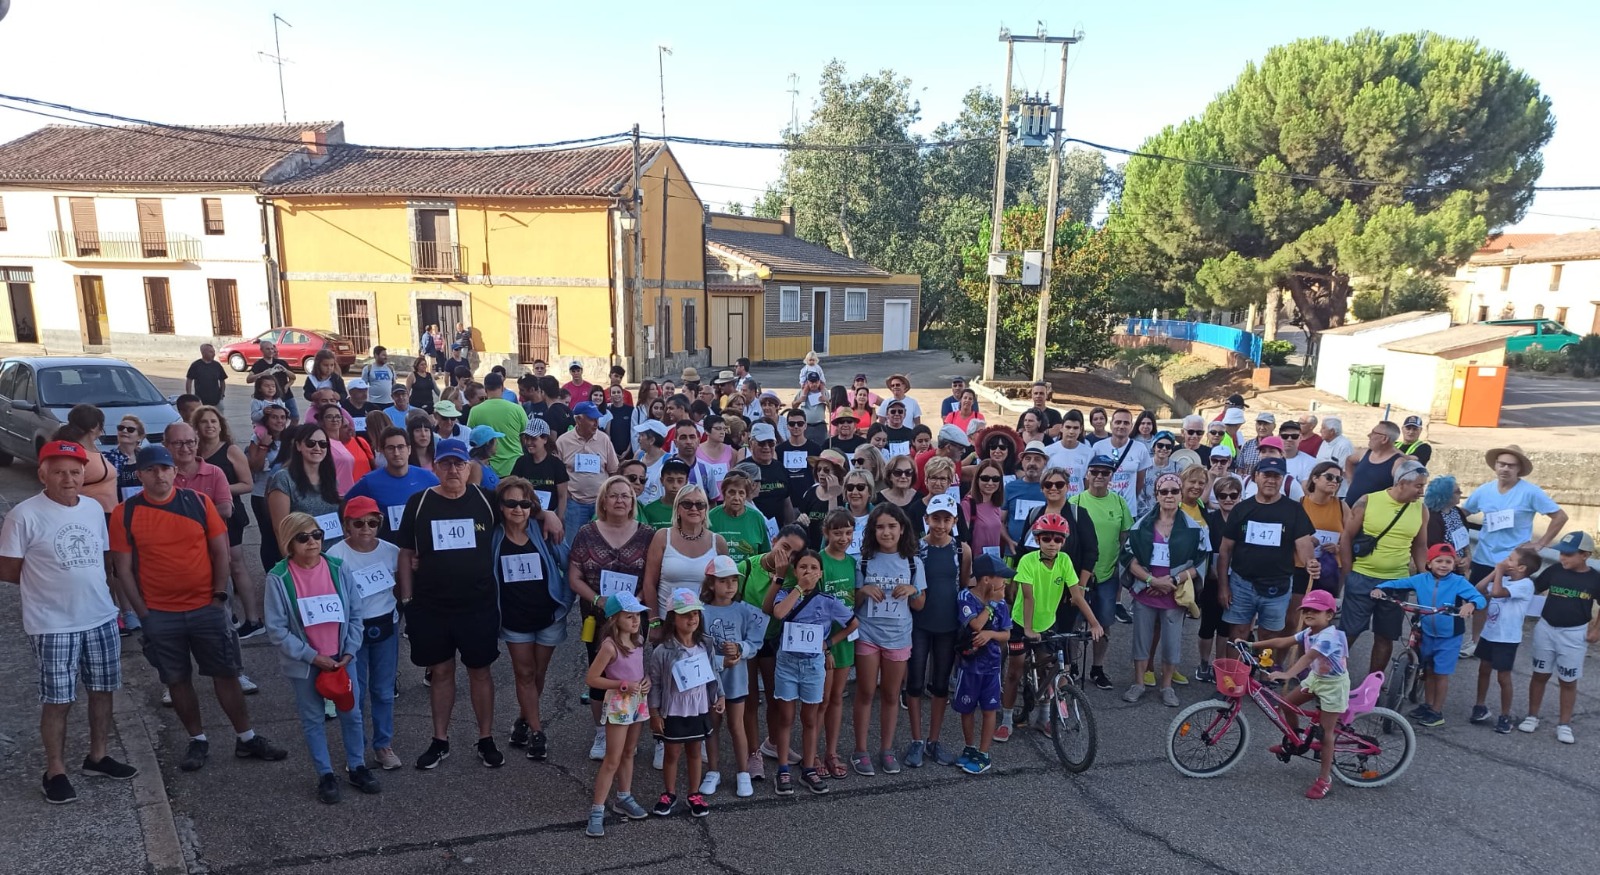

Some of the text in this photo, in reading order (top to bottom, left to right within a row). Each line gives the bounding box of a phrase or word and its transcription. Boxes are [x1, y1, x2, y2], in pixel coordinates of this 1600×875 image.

[584, 458, 597, 466] 205
[793, 456, 803, 464] 63
[713, 467, 723, 476] 62
[325, 520, 338, 531] 200
[448, 525, 465, 539] 40
[1259, 530, 1274, 540] 47
[518, 562, 532, 574] 41
[364, 570, 385, 585] 163
[613, 580, 632, 591] 118
[319, 602, 340, 613] 162
[884, 602, 899, 612] 17
[800, 630, 815, 642] 10
[693, 664, 701, 677] 7
